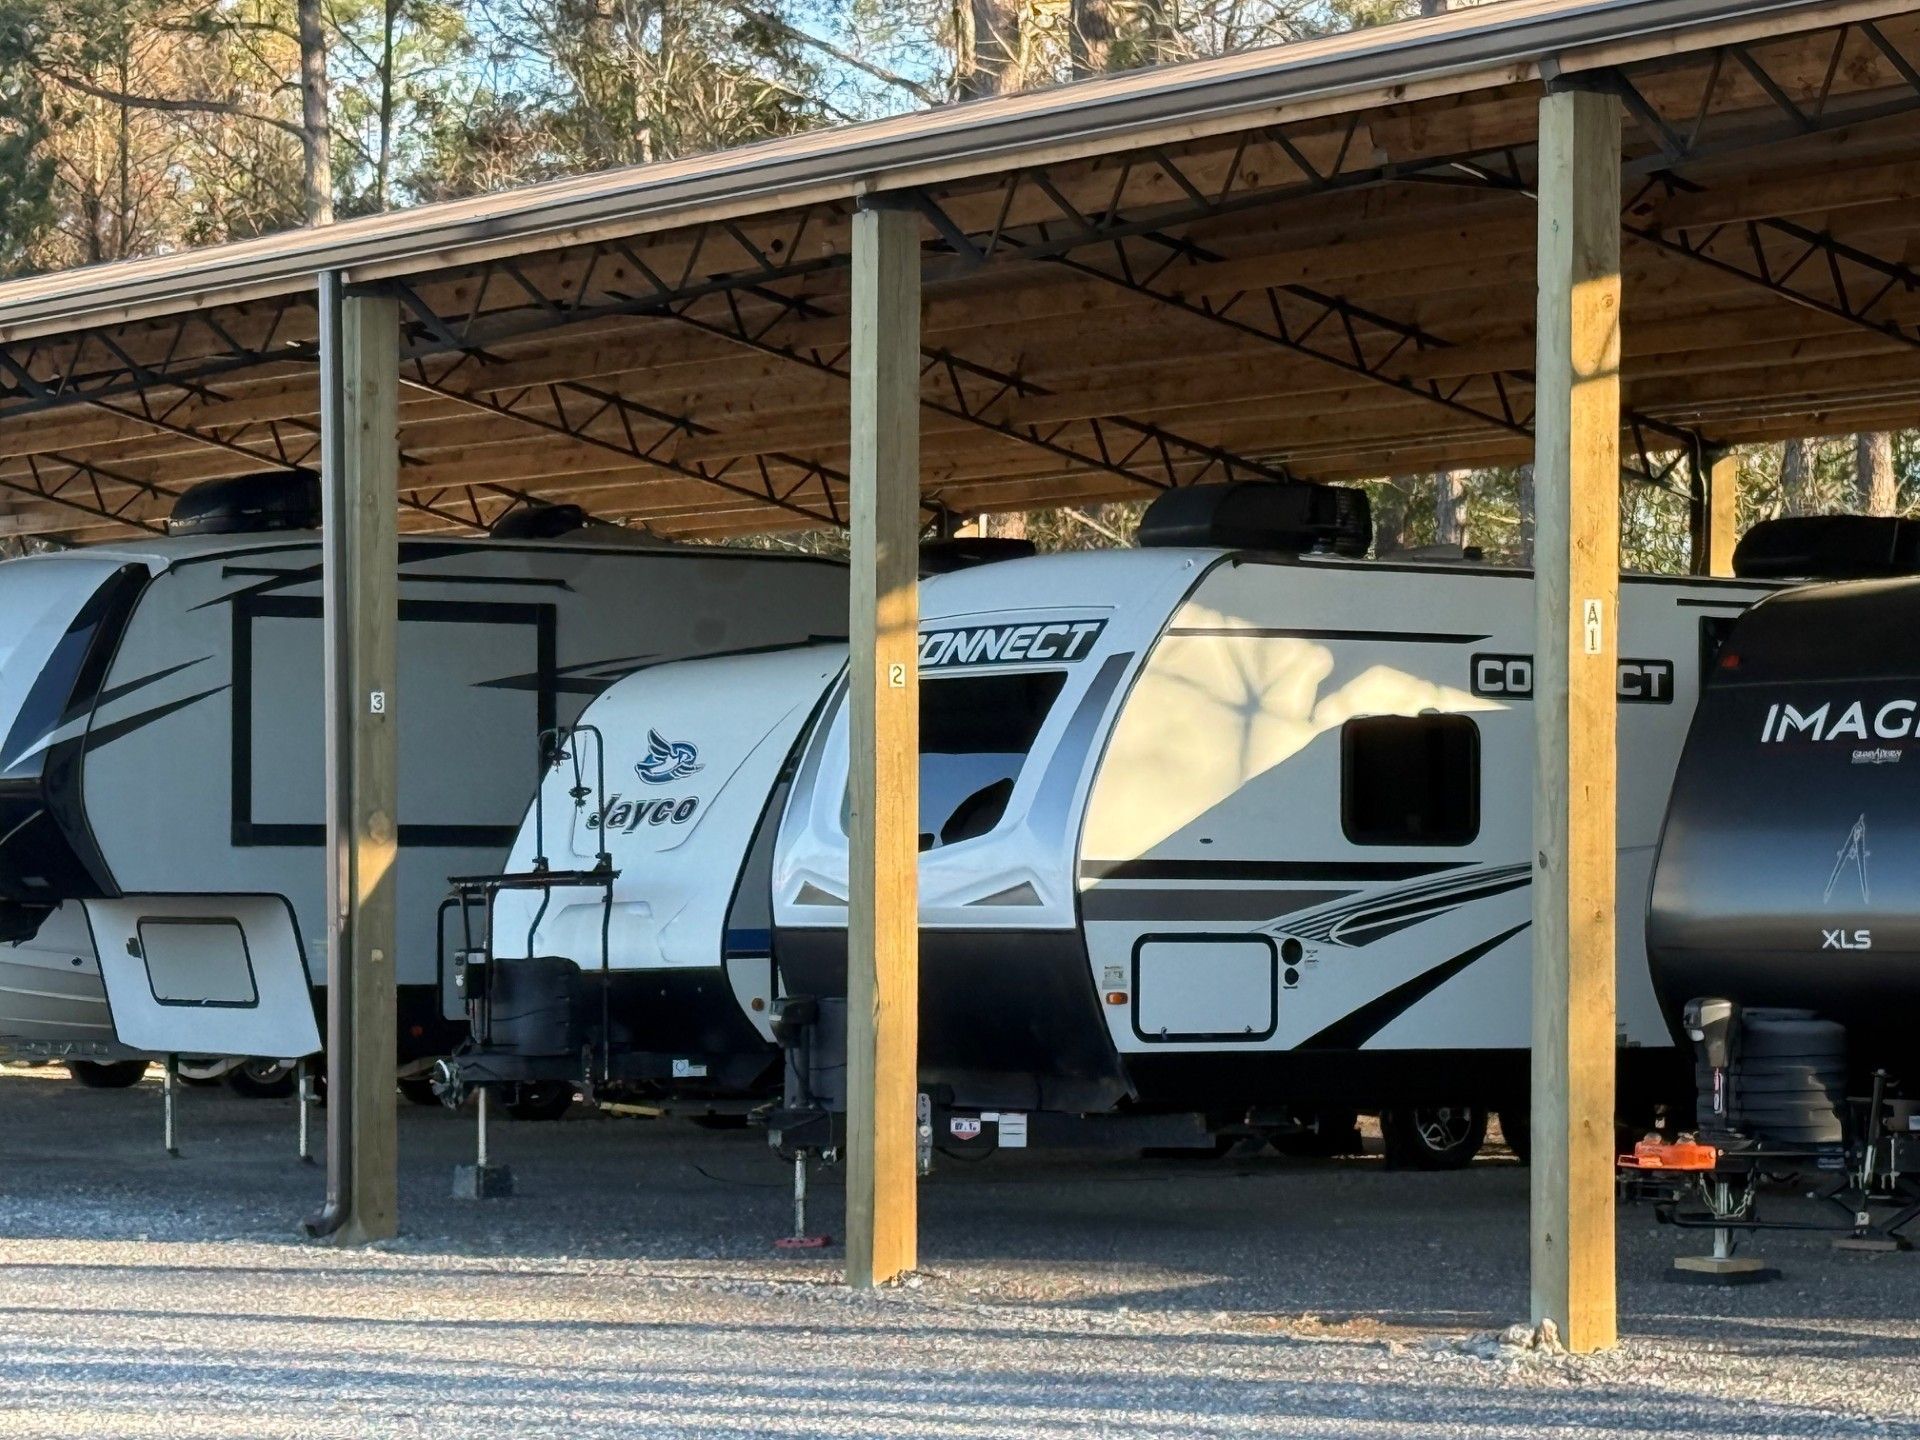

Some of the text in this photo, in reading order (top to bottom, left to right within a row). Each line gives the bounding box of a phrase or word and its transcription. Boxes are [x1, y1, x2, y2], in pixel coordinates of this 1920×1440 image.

[892, 665, 903, 685] 2
[1477, 659, 1667, 698] COCT
[373, 694, 383, 711] 3
[1760, 699, 1920, 743] IMAG
[586, 793, 700, 835] Jayco
[1821, 929, 1872, 949] XLS
